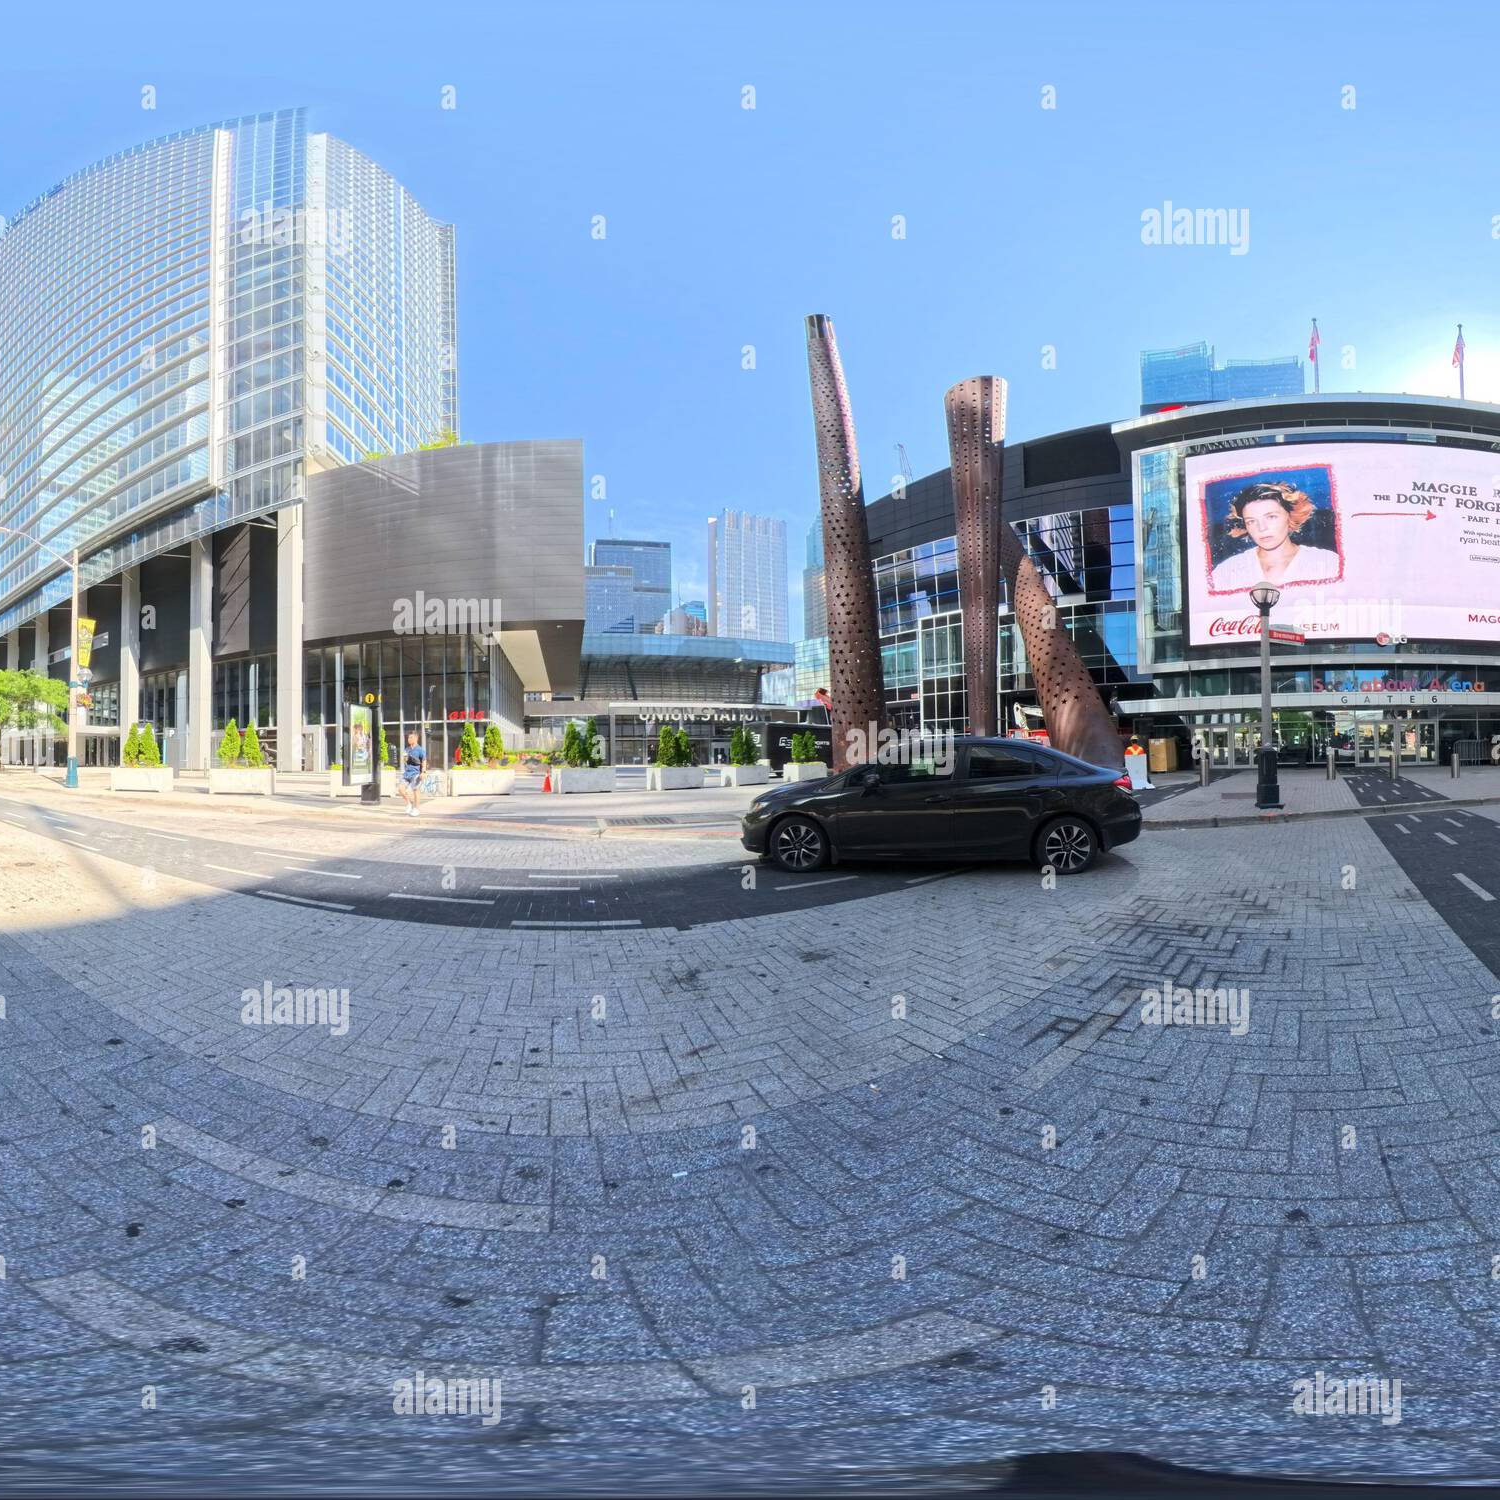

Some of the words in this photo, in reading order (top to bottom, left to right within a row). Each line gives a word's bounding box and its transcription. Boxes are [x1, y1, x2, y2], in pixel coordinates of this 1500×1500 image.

[1412, 481, 1477, 497] MAGGIE
[1396, 494, 1446, 506] DON'T
[1431, 695, 1438, 704] 6
[448, 707, 485, 721] aria
[639, 707, 695, 721] UNION
